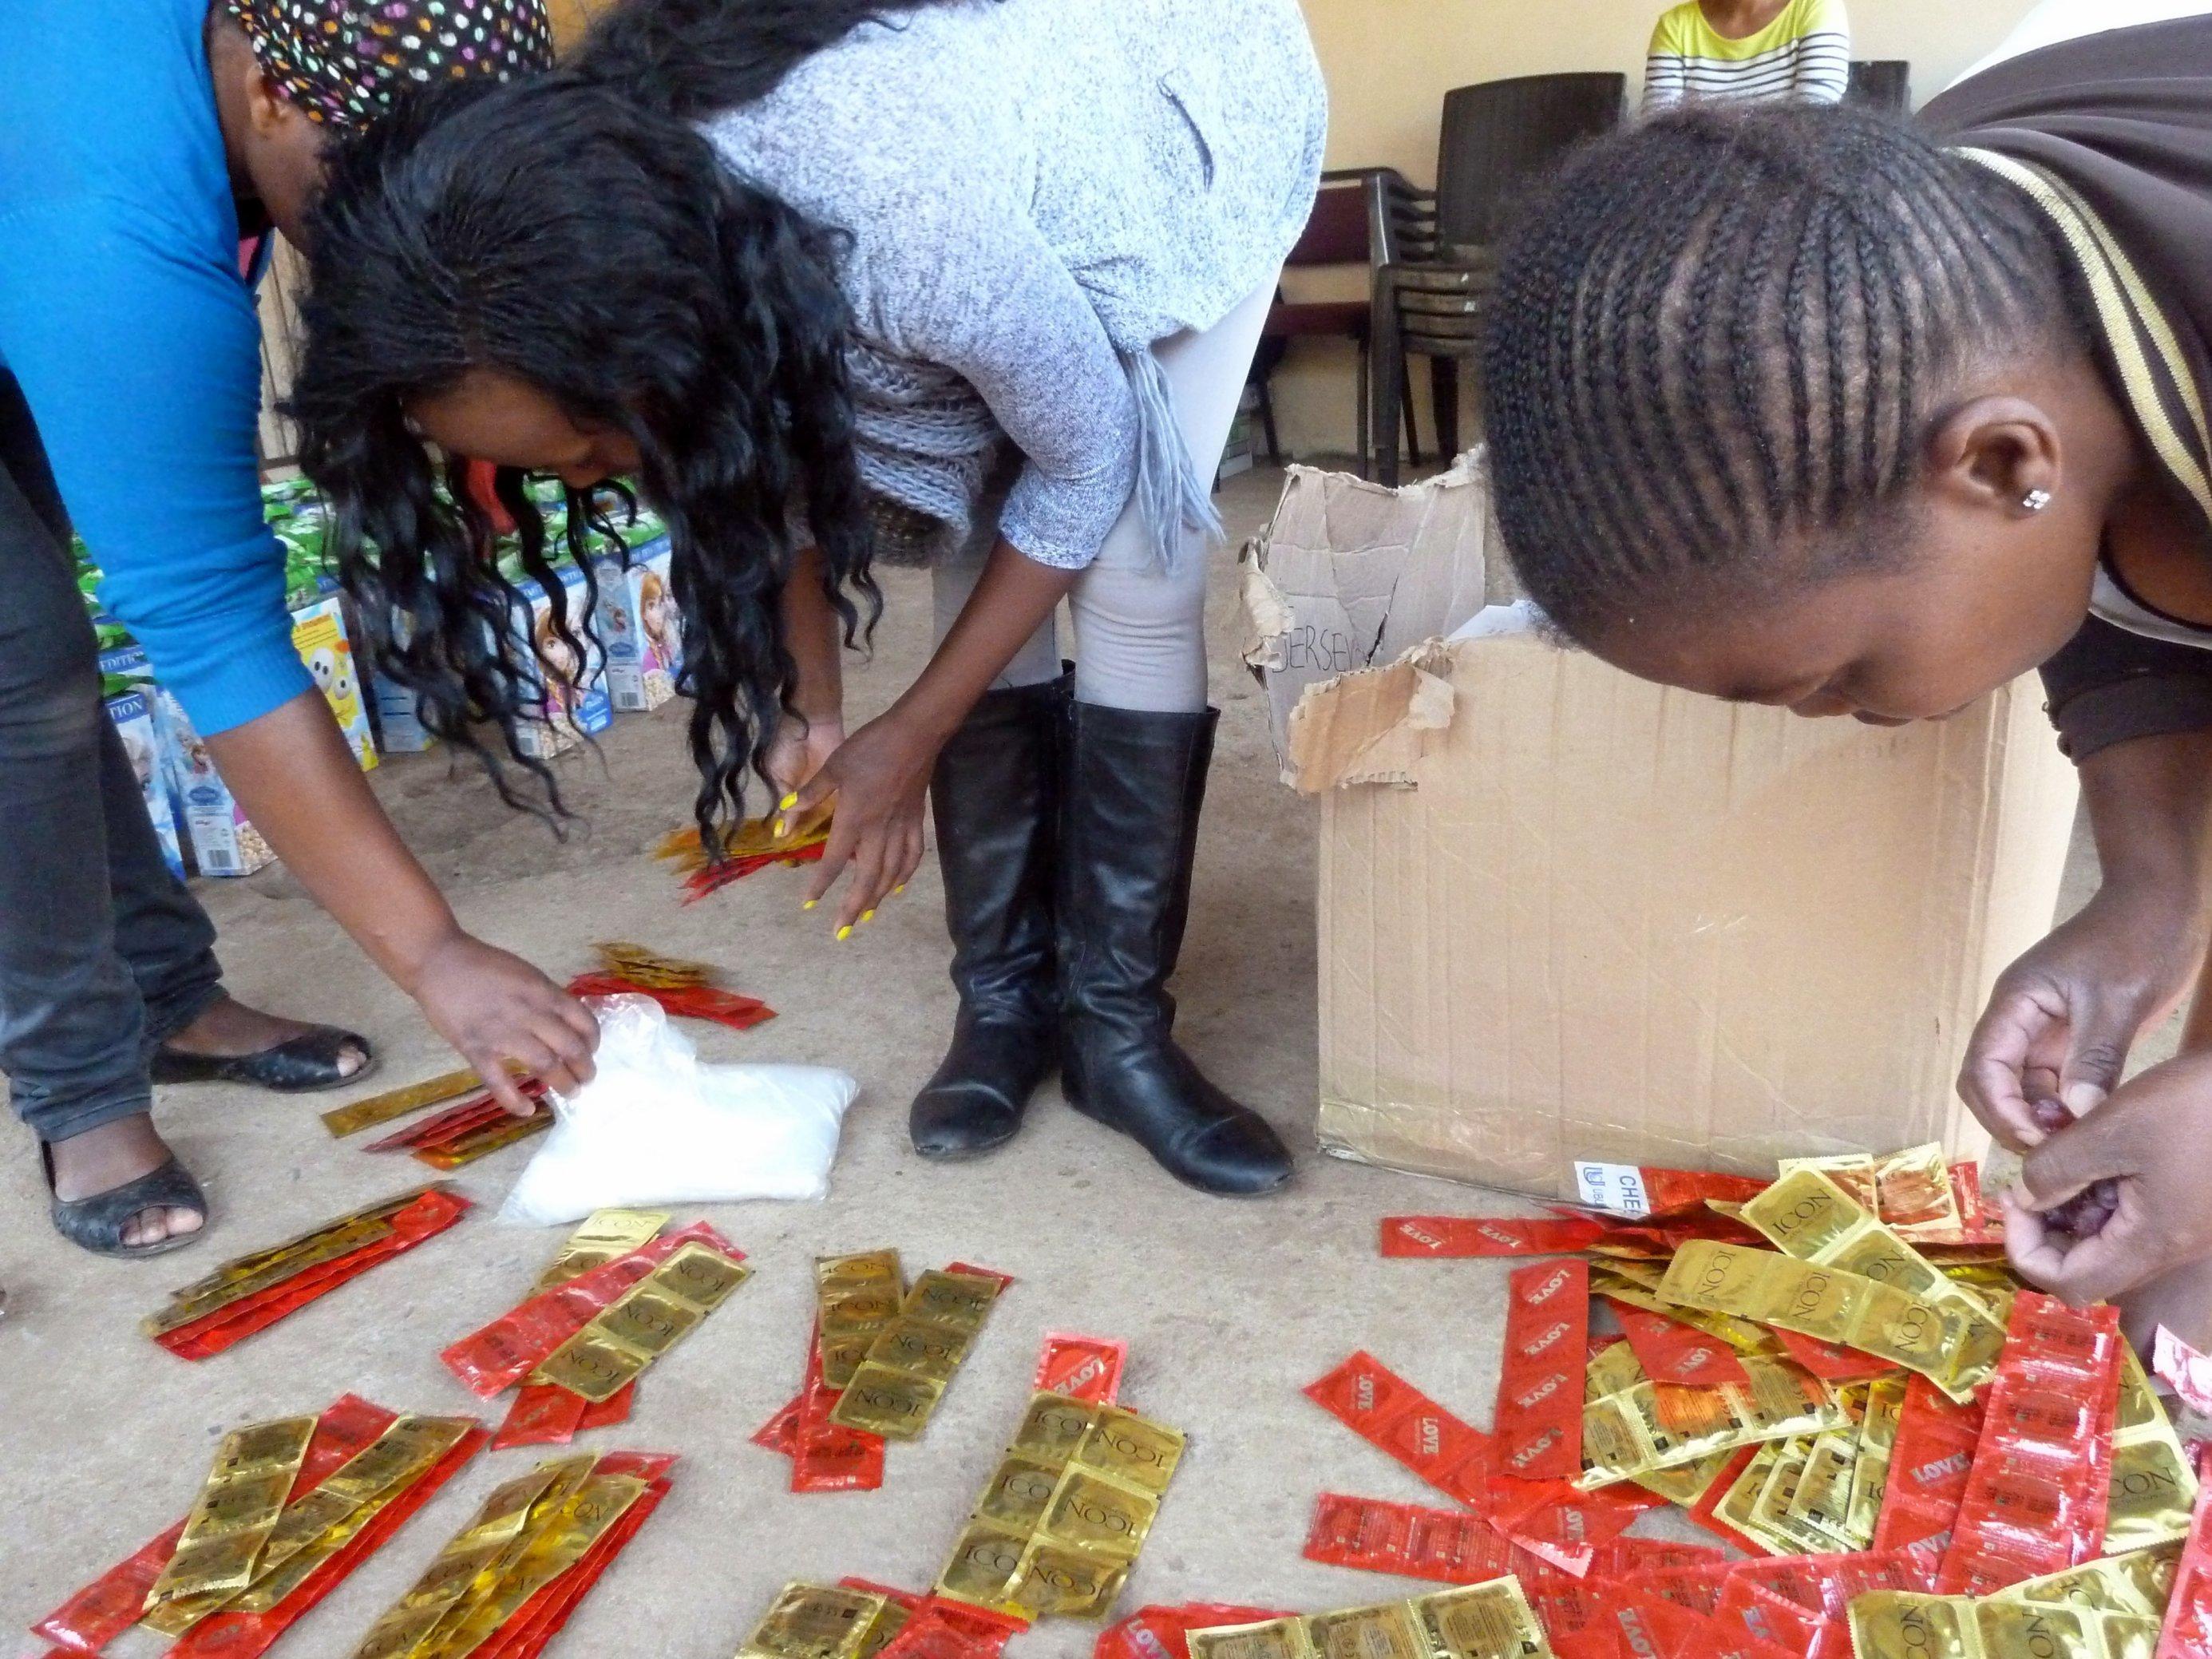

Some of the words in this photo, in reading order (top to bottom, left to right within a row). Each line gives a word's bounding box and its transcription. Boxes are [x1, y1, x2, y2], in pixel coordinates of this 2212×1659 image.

[1620, 1176, 1641, 1213] CHE
[1772, 1187, 1833, 1237] ICON
[1399, 1224, 1442, 1250] LOVE
[1478, 1225, 1522, 1248] LOVE
[1697, 1250, 1736, 1298] ICON
[1866, 1249, 1905, 1281] ON
[1528, 1269, 1571, 1305] LOVE
[1793, 1271, 1831, 1322] ICON
[1524, 1322, 1571, 1355] LOVE
[1895, 1301, 1933, 1355] ICON
[1517, 1373, 1569, 1408] LOVE
[1096, 1429, 1164, 1468] ICON
[1423, 1417, 1440, 1454] LOVE
[1511, 1427, 1565, 1468] LOVE
[1911, 1450, 1971, 1483] LOVE
[2107, 1466, 2177, 1499] CON
[999, 1475, 1051, 1499] ICO
[1064, 1498, 1136, 1538] ICON
[965, 1545, 1018, 1572] ICO
[1030, 1565, 1105, 1602] ICON
